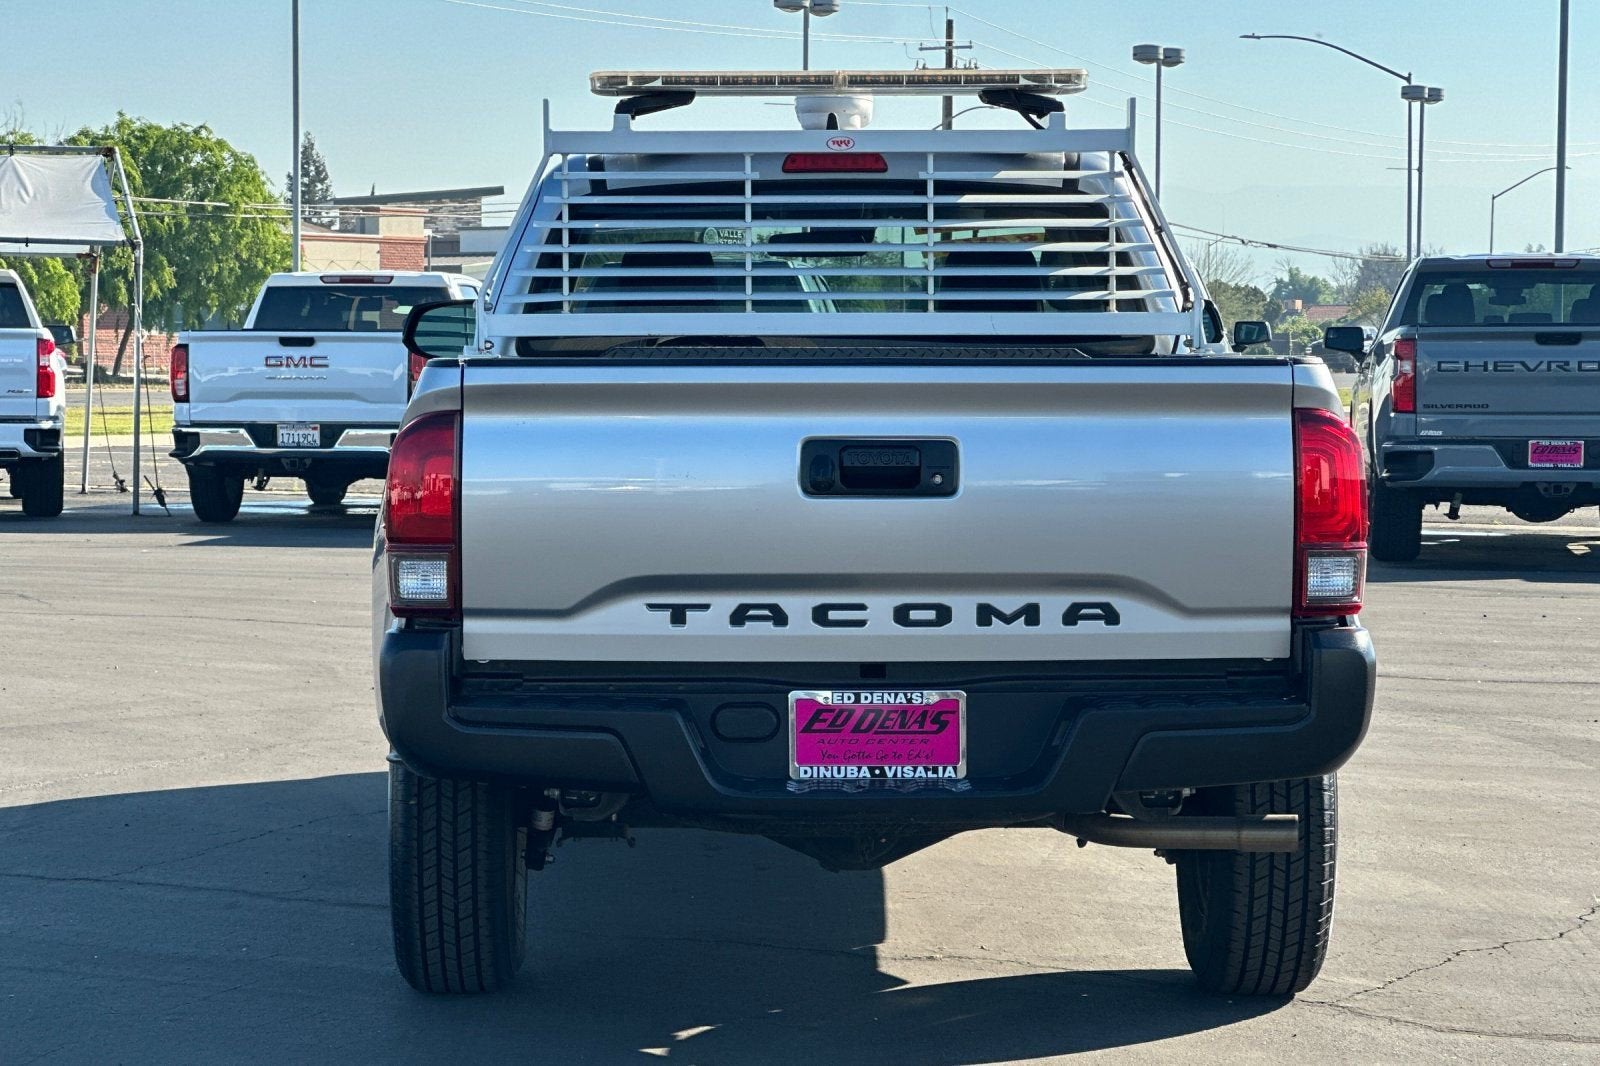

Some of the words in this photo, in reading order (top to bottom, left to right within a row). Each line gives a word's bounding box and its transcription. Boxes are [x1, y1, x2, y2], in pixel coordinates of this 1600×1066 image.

[264, 355, 330, 369] GMC
[1436, 360, 1600, 373] CHEVRO
[280, 432, 317, 444] 17119C4
[847, 451, 914, 465] TOYOTA
[645, 602, 1121, 628] TACOMA
[832, 692, 856, 704] ED
[860, 692, 923, 704] DENA'S
[800, 708, 855, 734] ED
[850, 708, 957, 736] DENA'S
[820, 749, 839, 761] You
[842, 749, 872, 762] Gotta
[875, 749, 888, 761] Go
[799, 766, 871, 778] DINUBA
[884, 766, 957, 778] VISALIA
